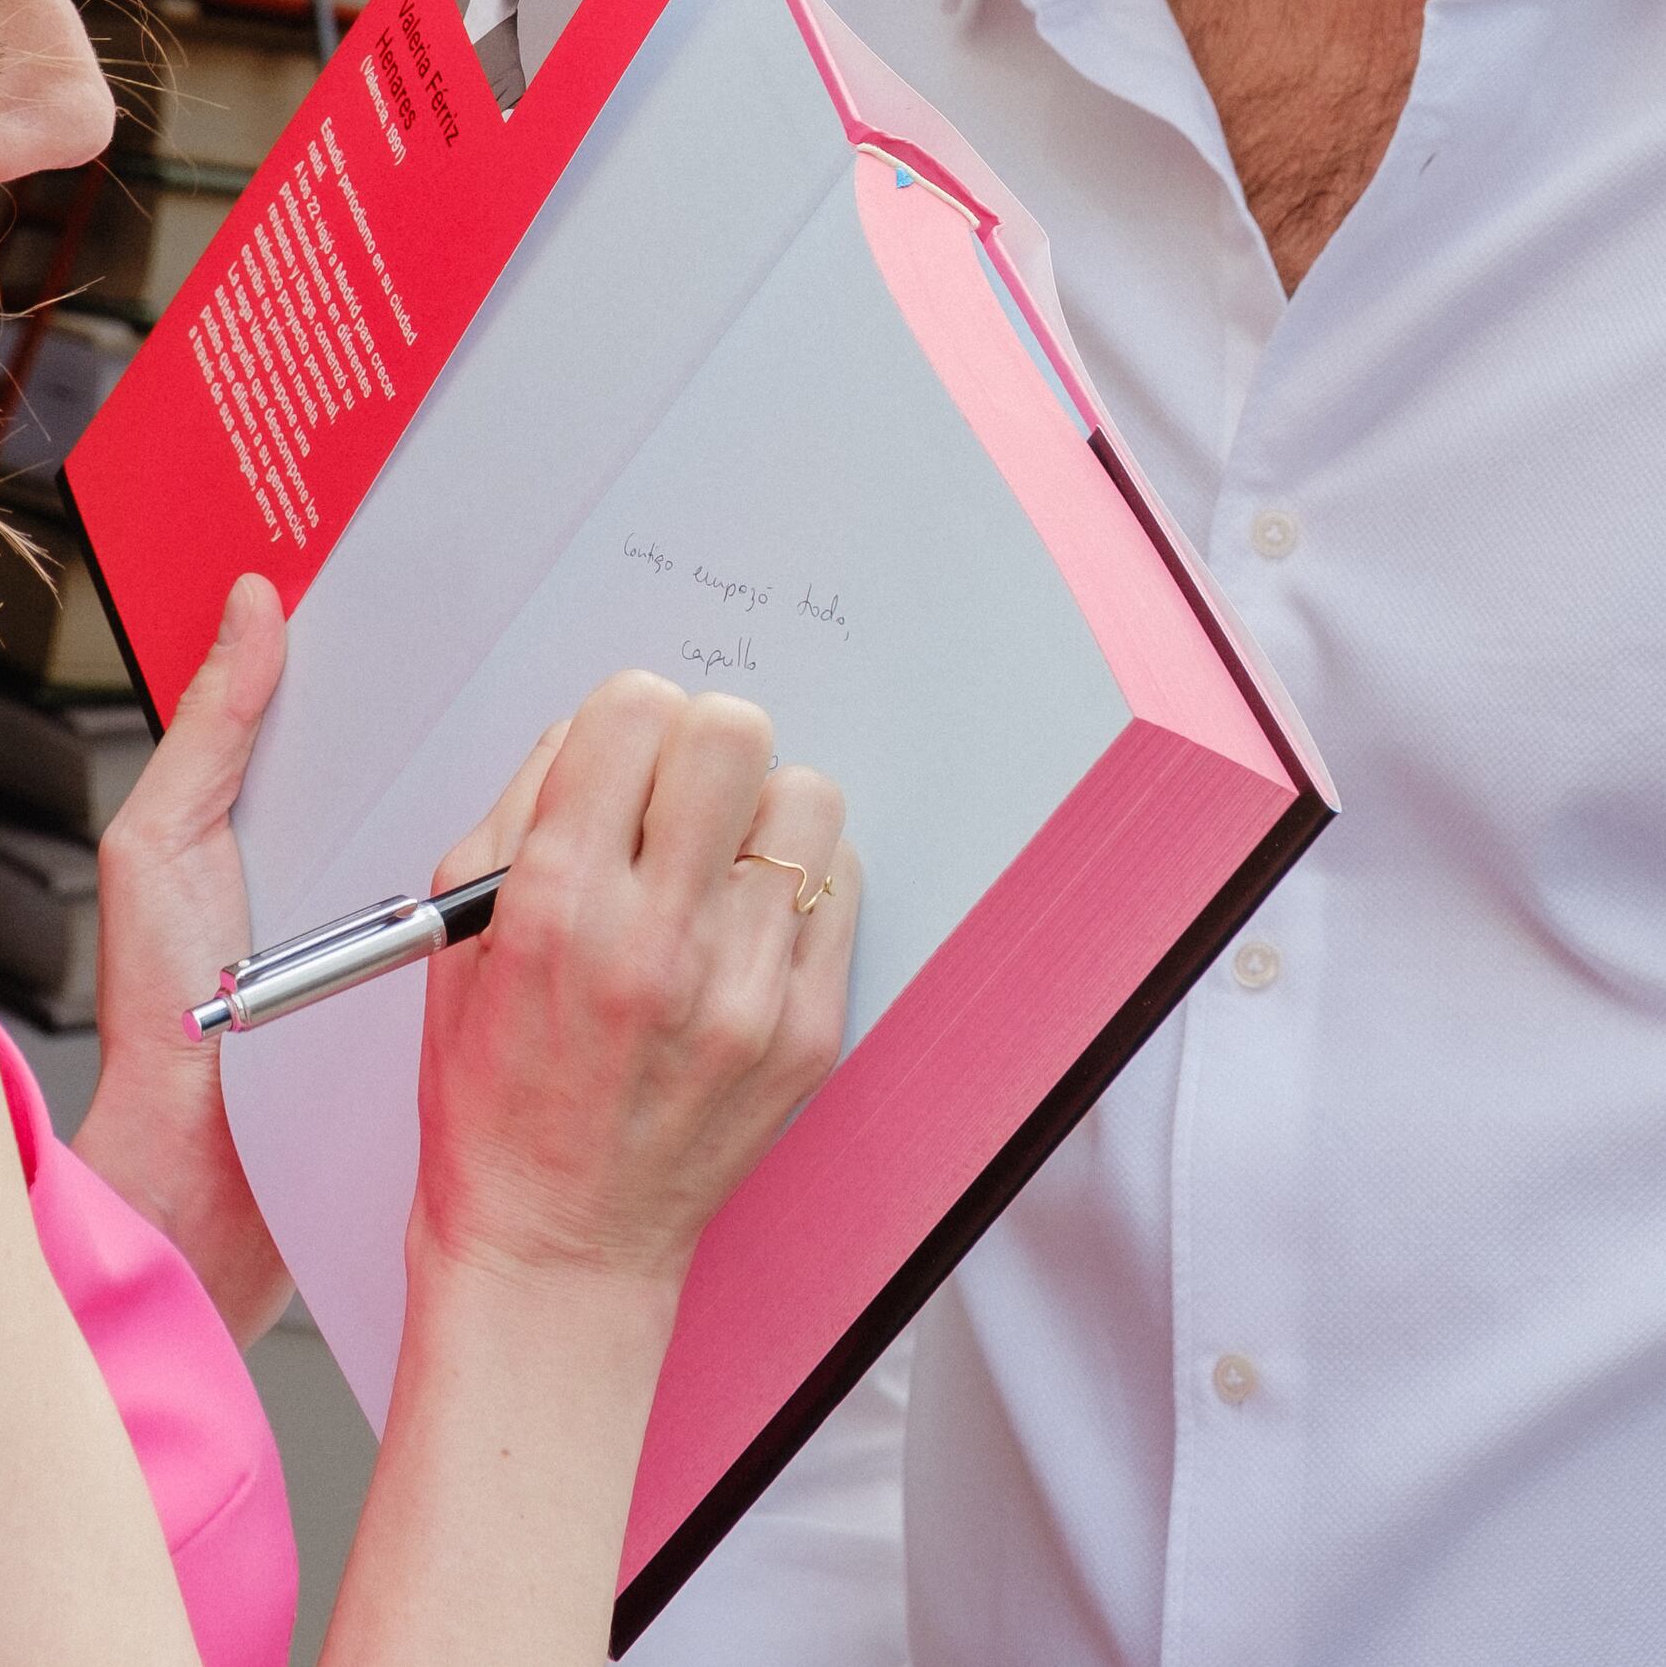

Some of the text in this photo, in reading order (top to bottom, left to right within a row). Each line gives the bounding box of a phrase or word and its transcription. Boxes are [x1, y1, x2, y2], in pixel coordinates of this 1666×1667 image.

[376, 27, 416, 130] Henares
[426, 71, 459, 147] Férriz
[295, 161, 304, 177] A
[299, 172, 311, 199] los
[308, 141, 327, 181] natal.
[387, 124, 406, 165] 1991)
[307, 196, 320, 220] 22
[321, 117, 417, 345] Estudió periodismo en su ciudad
[329, 254, 337, 266] a
[334, 262, 361, 318] Madrid
[228, 262, 239, 286] La
[250, 317, 273, 372] Valeria
[270, 371, 297, 426] supone
[295, 426, 309, 457] una
[242, 244, 317, 428] escribir su primera novela.
[277, 290, 309, 354] proyecto
[304, 354, 339, 424] personal,
[289, 266, 299, 279] y
[296, 274, 316, 324] blogs,
[315, 322, 348, 389] comenzó
[343, 389, 355, 410] su
[328, 303, 340, 324] en
[337, 324, 371, 398] diferentes
[354, 317, 374, 354] para
[372, 353, 395, 400] crecer
[189, 326, 197, 338] a
[211, 383, 223, 404] de
[220, 403, 234, 431] sus
[231, 431, 257, 490] amigas,
[256, 488, 277, 527] amor
[271, 528, 281, 542] y
[220, 353, 235, 382] que
[254, 433, 262, 446] a
[259, 445, 271, 466] su
[252, 378, 267, 408] que
[265, 408, 308, 503] descompone
[305, 498, 319, 527] los
